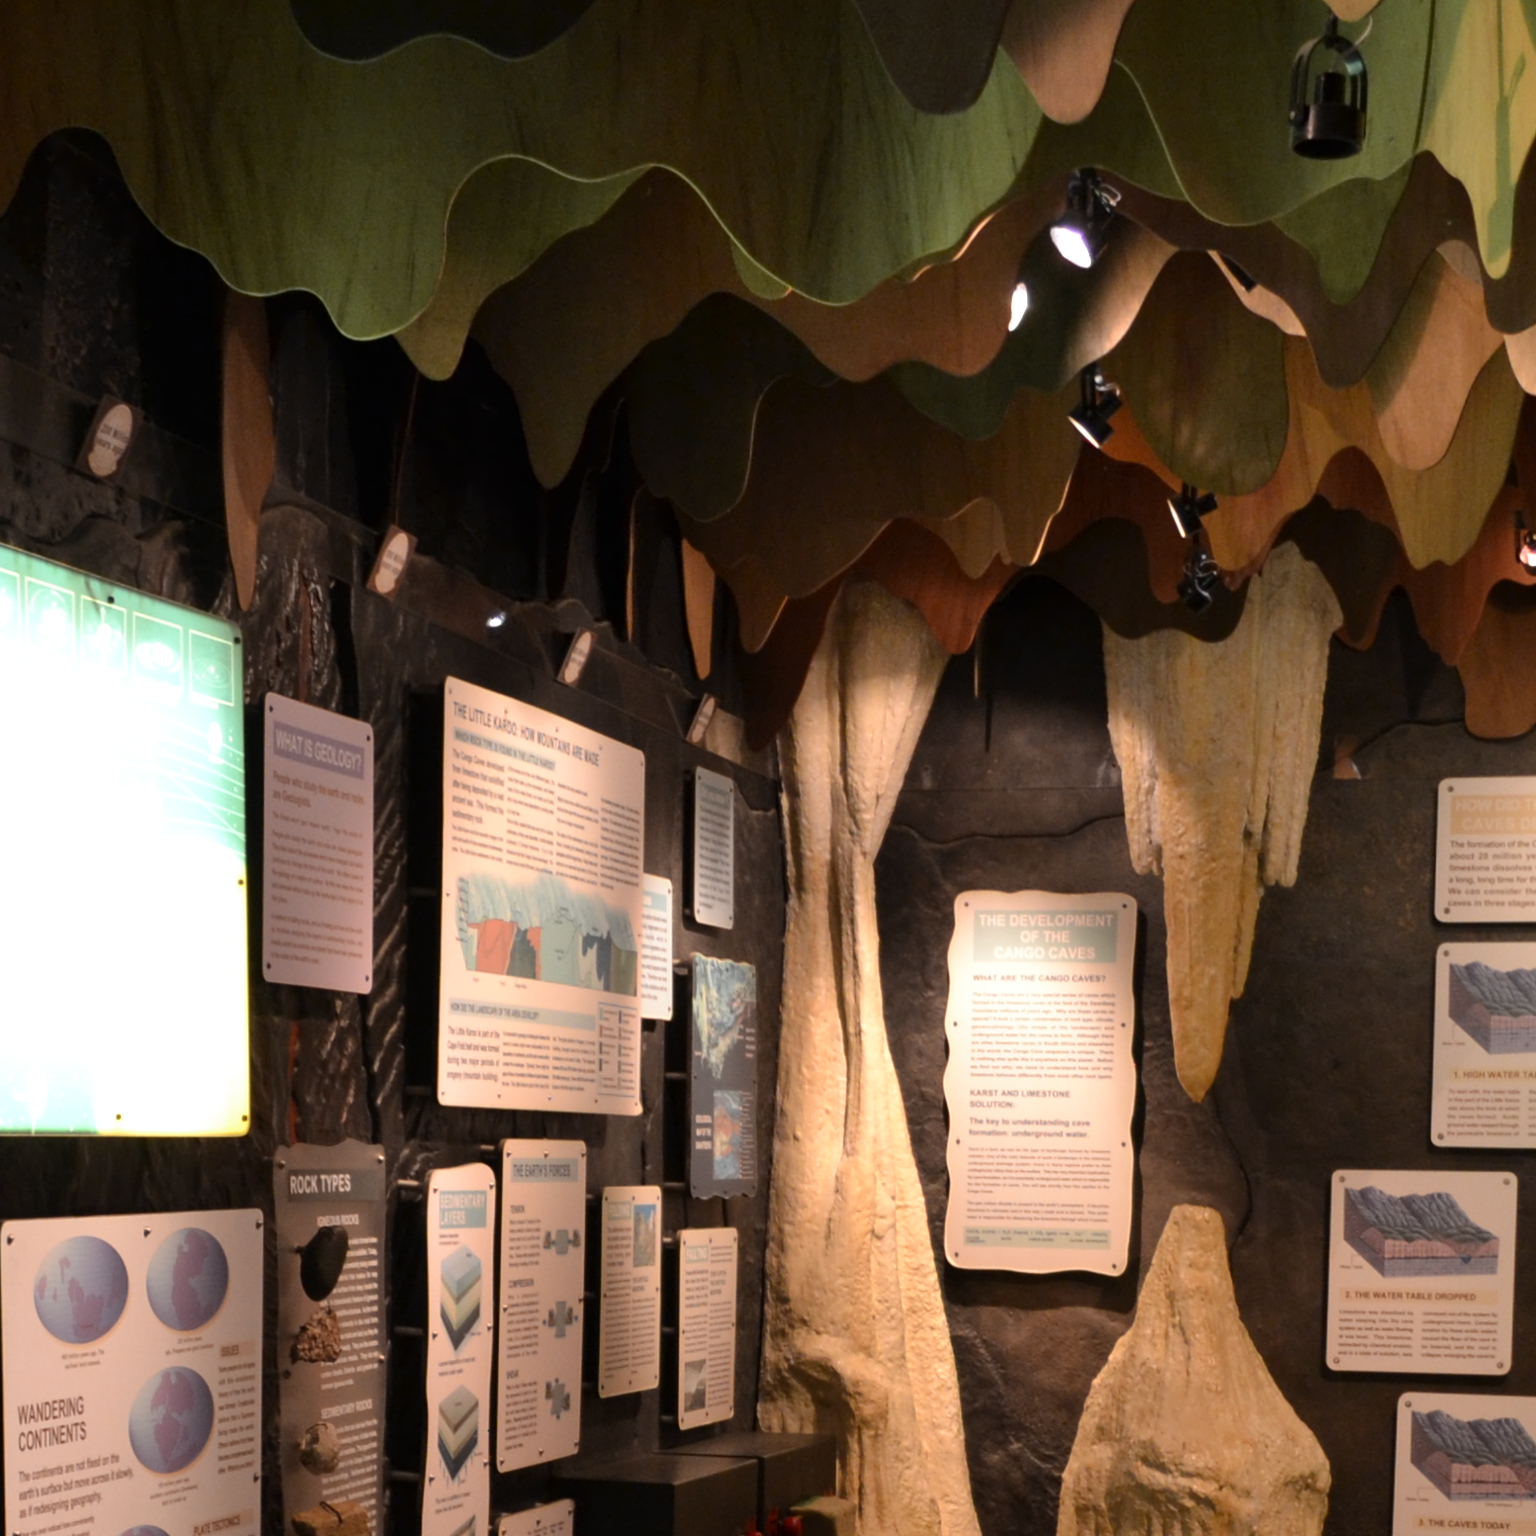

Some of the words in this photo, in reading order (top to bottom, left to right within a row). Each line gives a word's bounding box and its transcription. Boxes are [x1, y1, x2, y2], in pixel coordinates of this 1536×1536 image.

[275, 729, 303, 755] WHAT
[304, 737, 313, 757] IS
[315, 740, 361, 771] GEOLOGY?
[979, 914, 1005, 926] THE
[1010, 914, 1113, 927] DEVELOPMENT
[1020, 930, 1039, 943] OF
[1043, 930, 1070, 943] THE
[994, 947, 1045, 959] CANGO
[1048, 947, 1095, 959] CAVES
[1022, 1090, 1070, 1098] LIMESTONE
[986, 1118, 999, 1127] key
[1012, 1119, 1069, 1127] understanding
[1012, 1130, 1063, 1138] underground
[290, 1176, 318, 1194] ROCK
[320, 1174, 351, 1192] TYPES
[1355, 1291, 1370, 1299] THE
[1435, 1293, 1476, 1301] DROPPED
[17, 1396, 85, 1425] WANDERING
[18, 1421, 87, 1452] CONTINENTS
[1448, 1520, 1478, 1528] CAVES
[1481, 1521, 1511, 1530] TODAY
